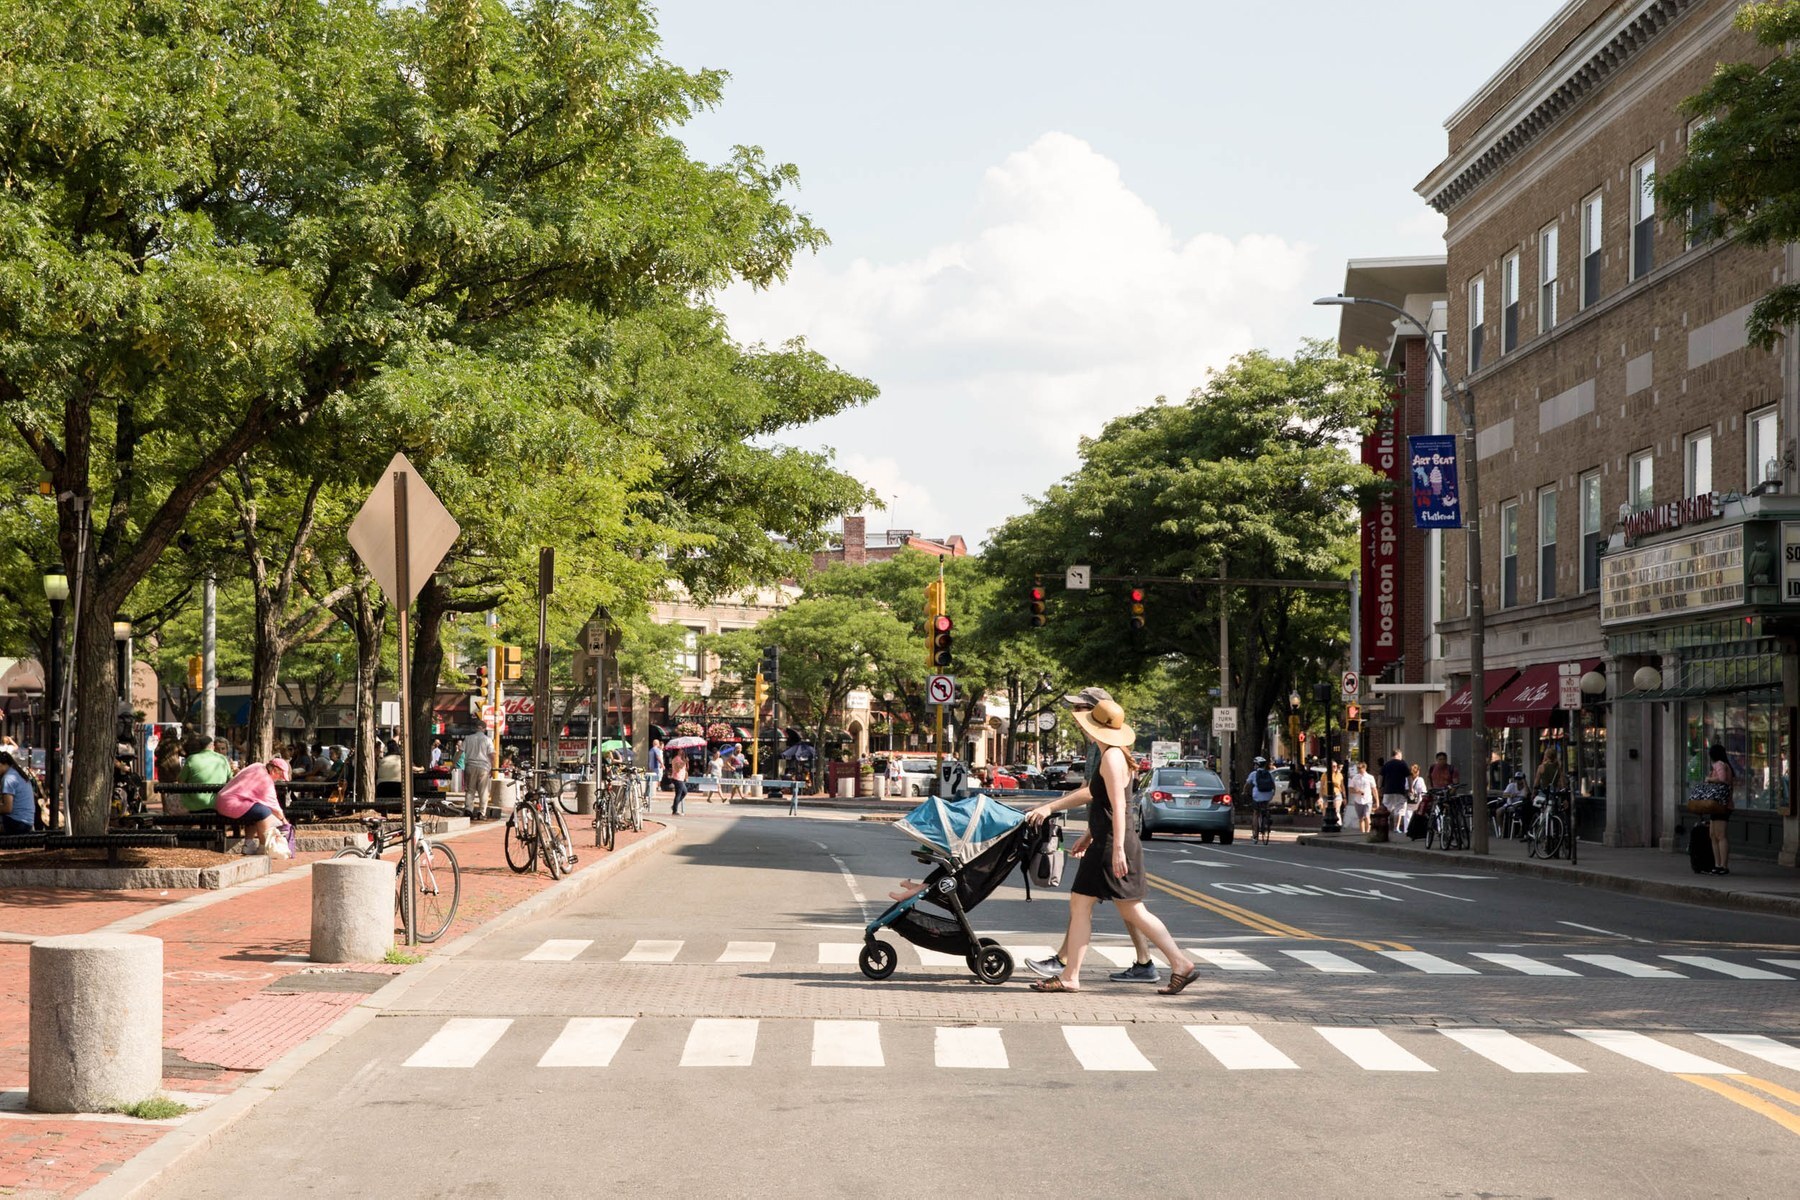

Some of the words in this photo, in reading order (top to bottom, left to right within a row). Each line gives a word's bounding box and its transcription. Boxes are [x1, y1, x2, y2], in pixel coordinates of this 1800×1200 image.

[1624, 502, 1677, 541] SOMERVILLE
[1677, 491, 1719, 524] THEATRE
[1376, 564, 1394, 647] boston
[1209, 882, 1405, 902] ONLY
